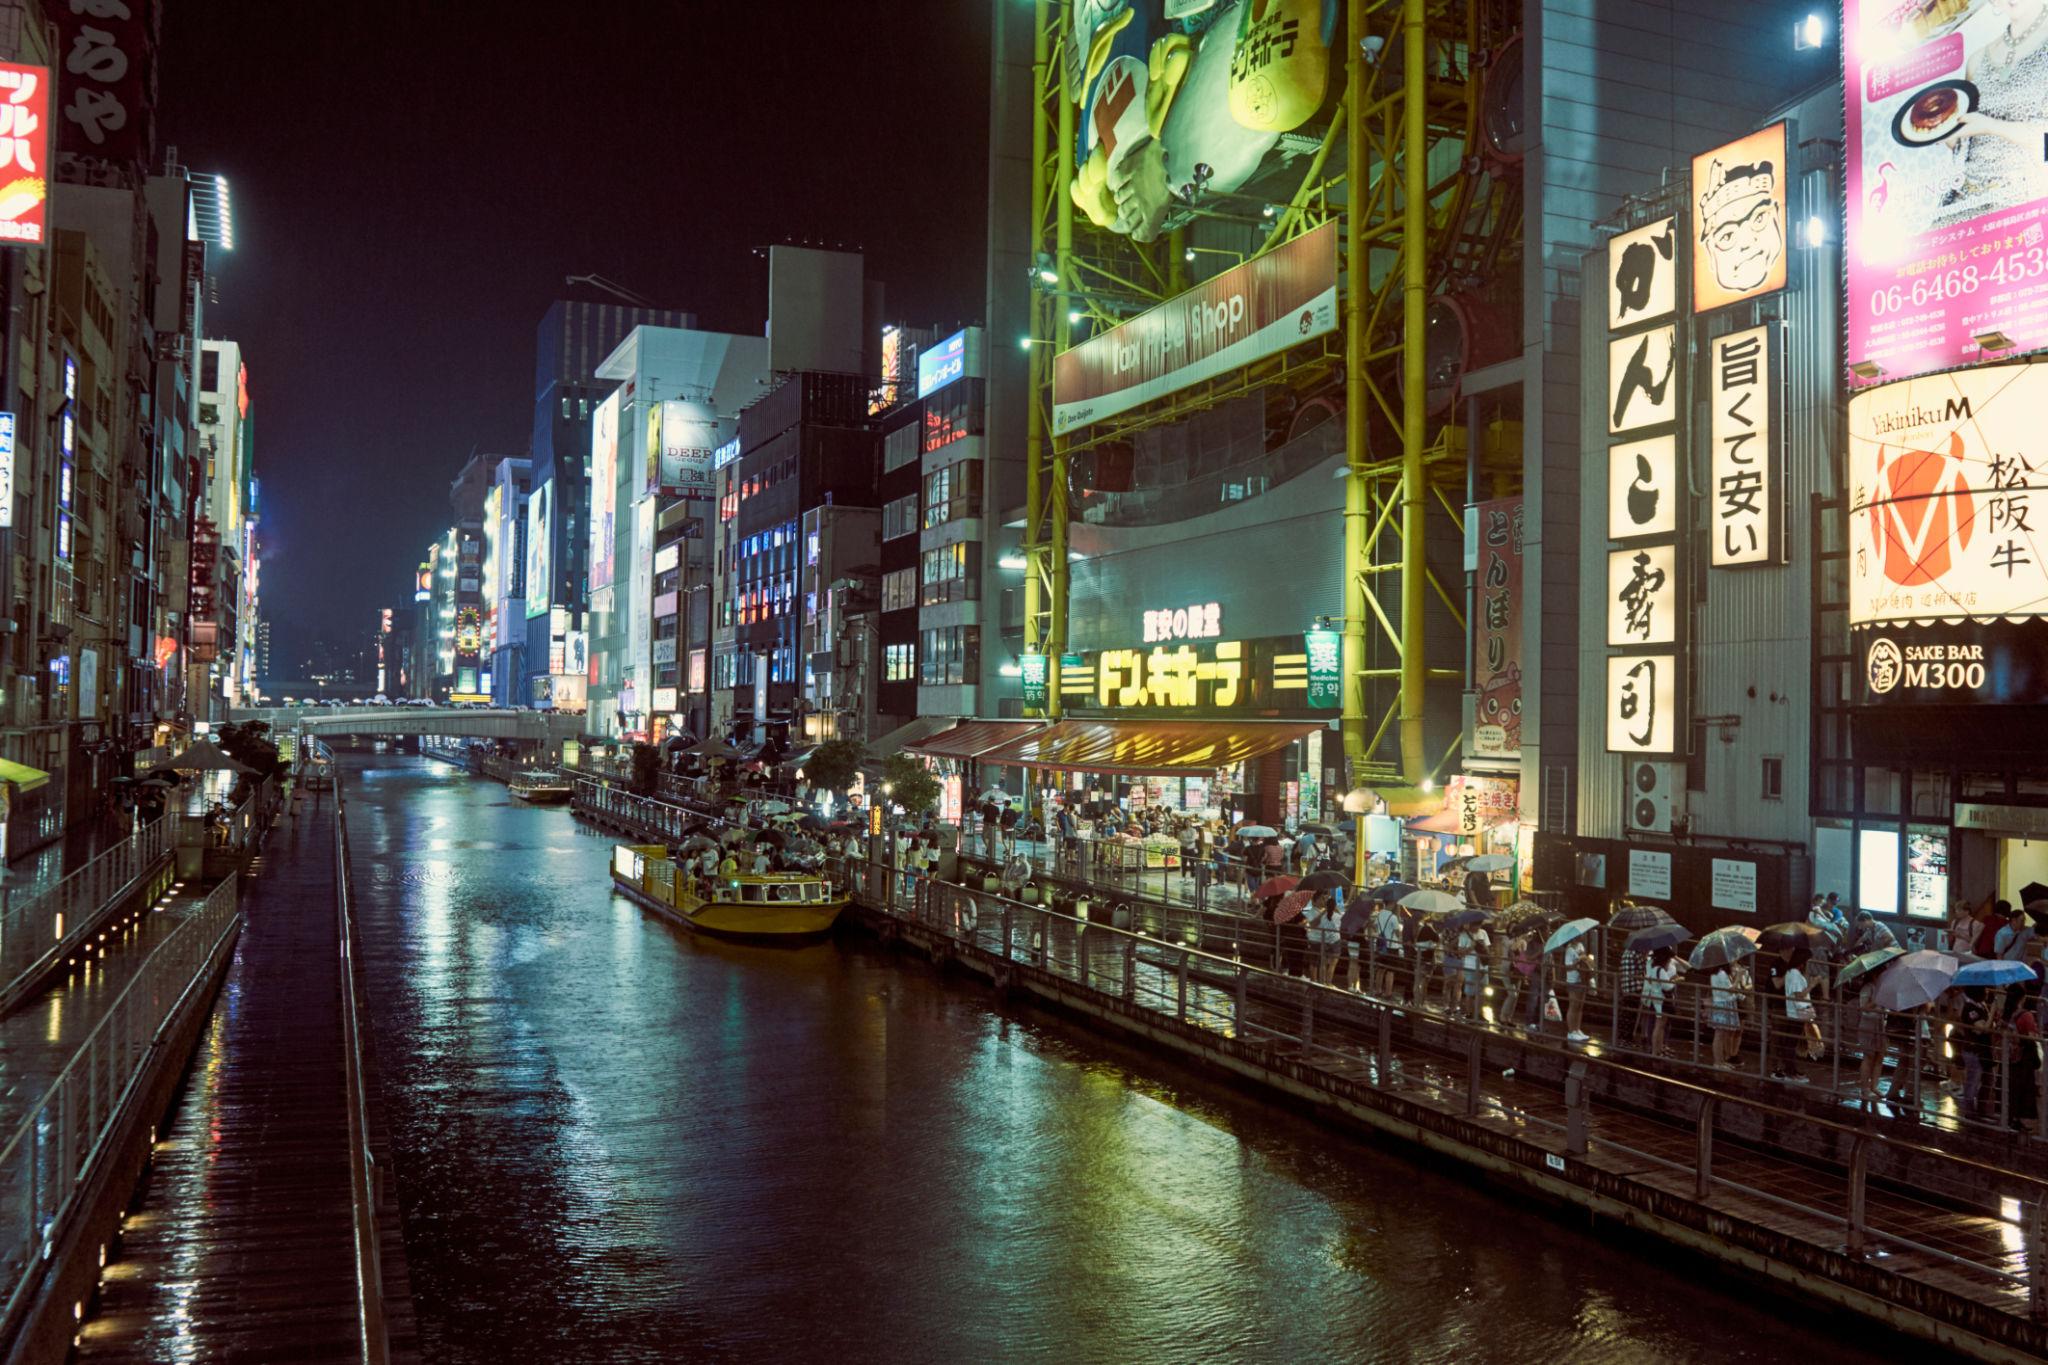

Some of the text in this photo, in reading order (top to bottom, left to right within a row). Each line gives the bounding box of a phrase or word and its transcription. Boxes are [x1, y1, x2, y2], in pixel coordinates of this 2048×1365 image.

[1870, 248, 2048, 316] 06-6468-453
[1944, 397, 1973, 421] M
[668, 447, 712, 458] DEEP
[1718, 336, 1765, 557] 旨くて安い
[1987, 452, 2035, 579] 松阪牛
[1486, 510, 1510, 673] とんぼり
[1904, 662, 1985, 689] M300
[1905, 645, 1984, 660] SAKE BAR
